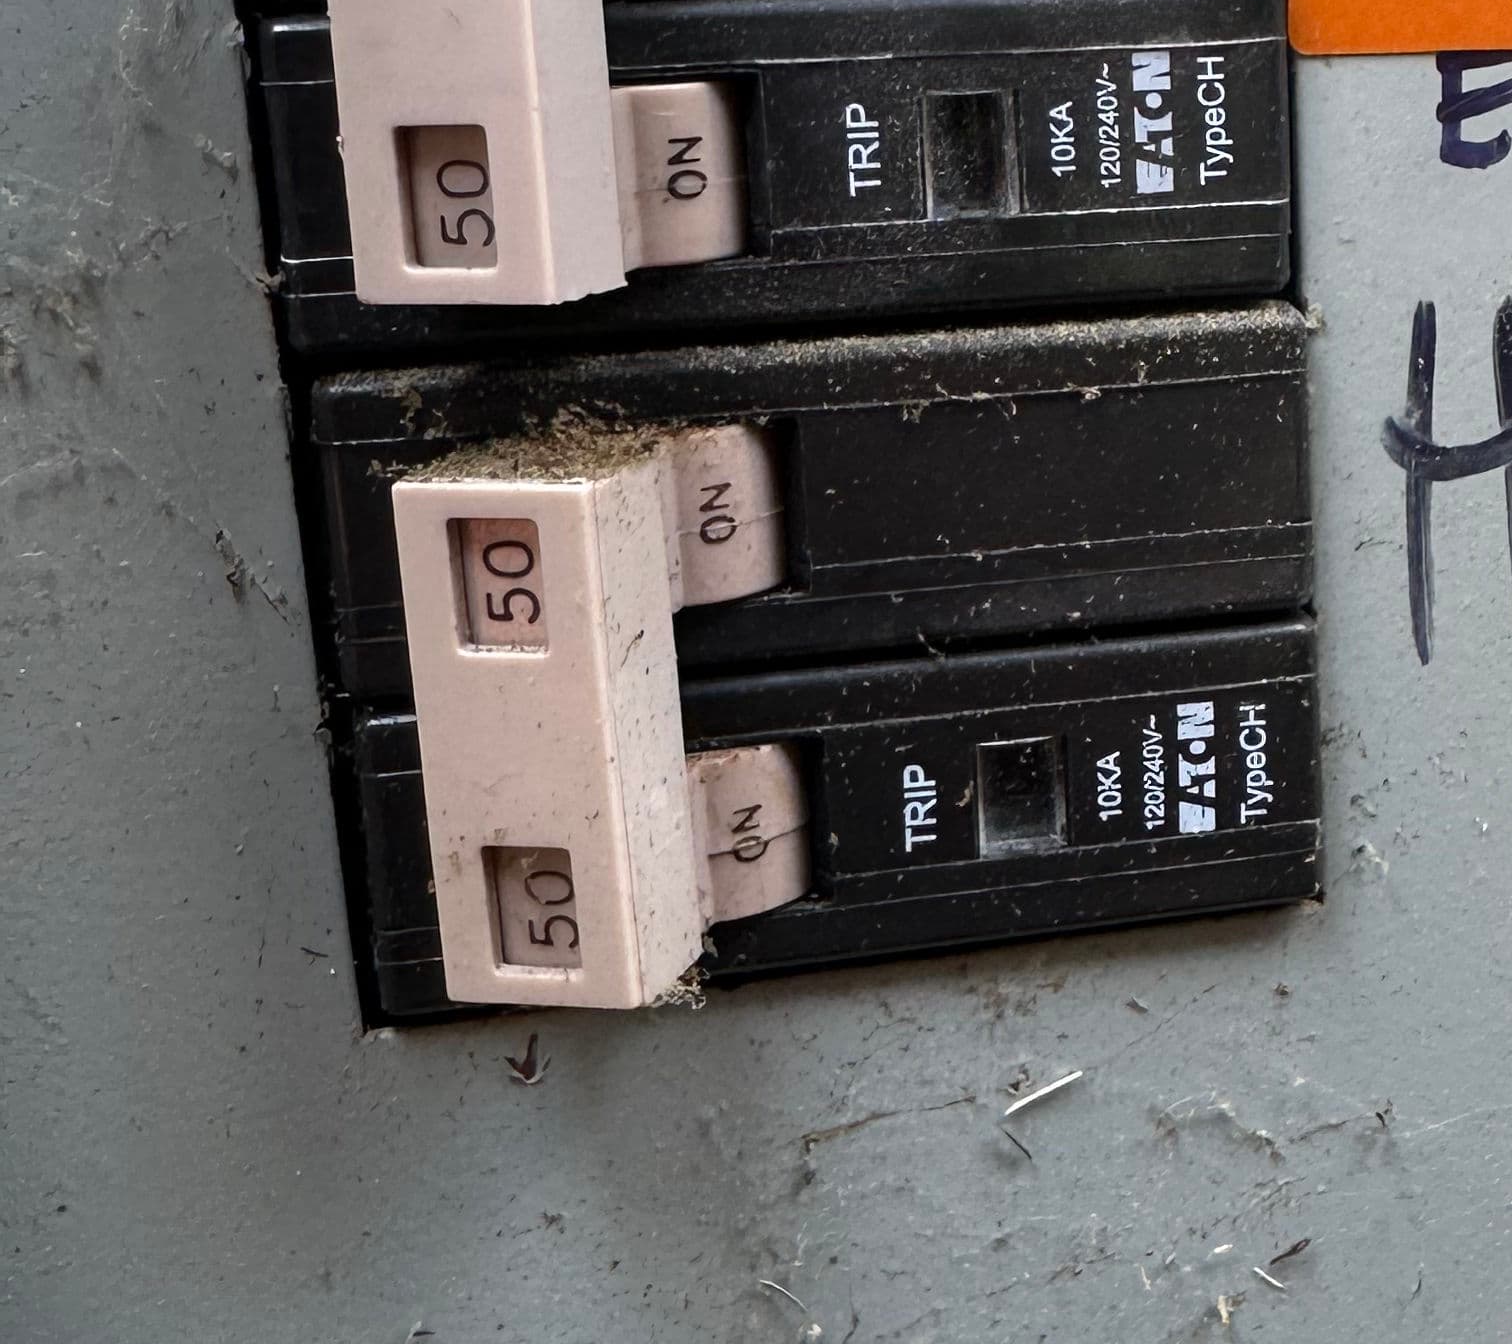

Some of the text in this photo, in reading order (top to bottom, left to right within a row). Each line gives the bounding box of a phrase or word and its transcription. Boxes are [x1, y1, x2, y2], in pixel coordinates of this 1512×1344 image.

[667, 136, 708, 201] ON
[845, 103, 882, 196] TRIP
[1049, 100, 1075, 177] 10KA
[437, 159, 496, 247] 50
[698, 481, 738, 546] ON
[483, 539, 542, 626] 50
[904, 764, 937, 853] TRIP
[1097, 751, 1122, 822] 10KA
[731, 803, 771, 863] ON
[524, 869, 580, 951] 50
